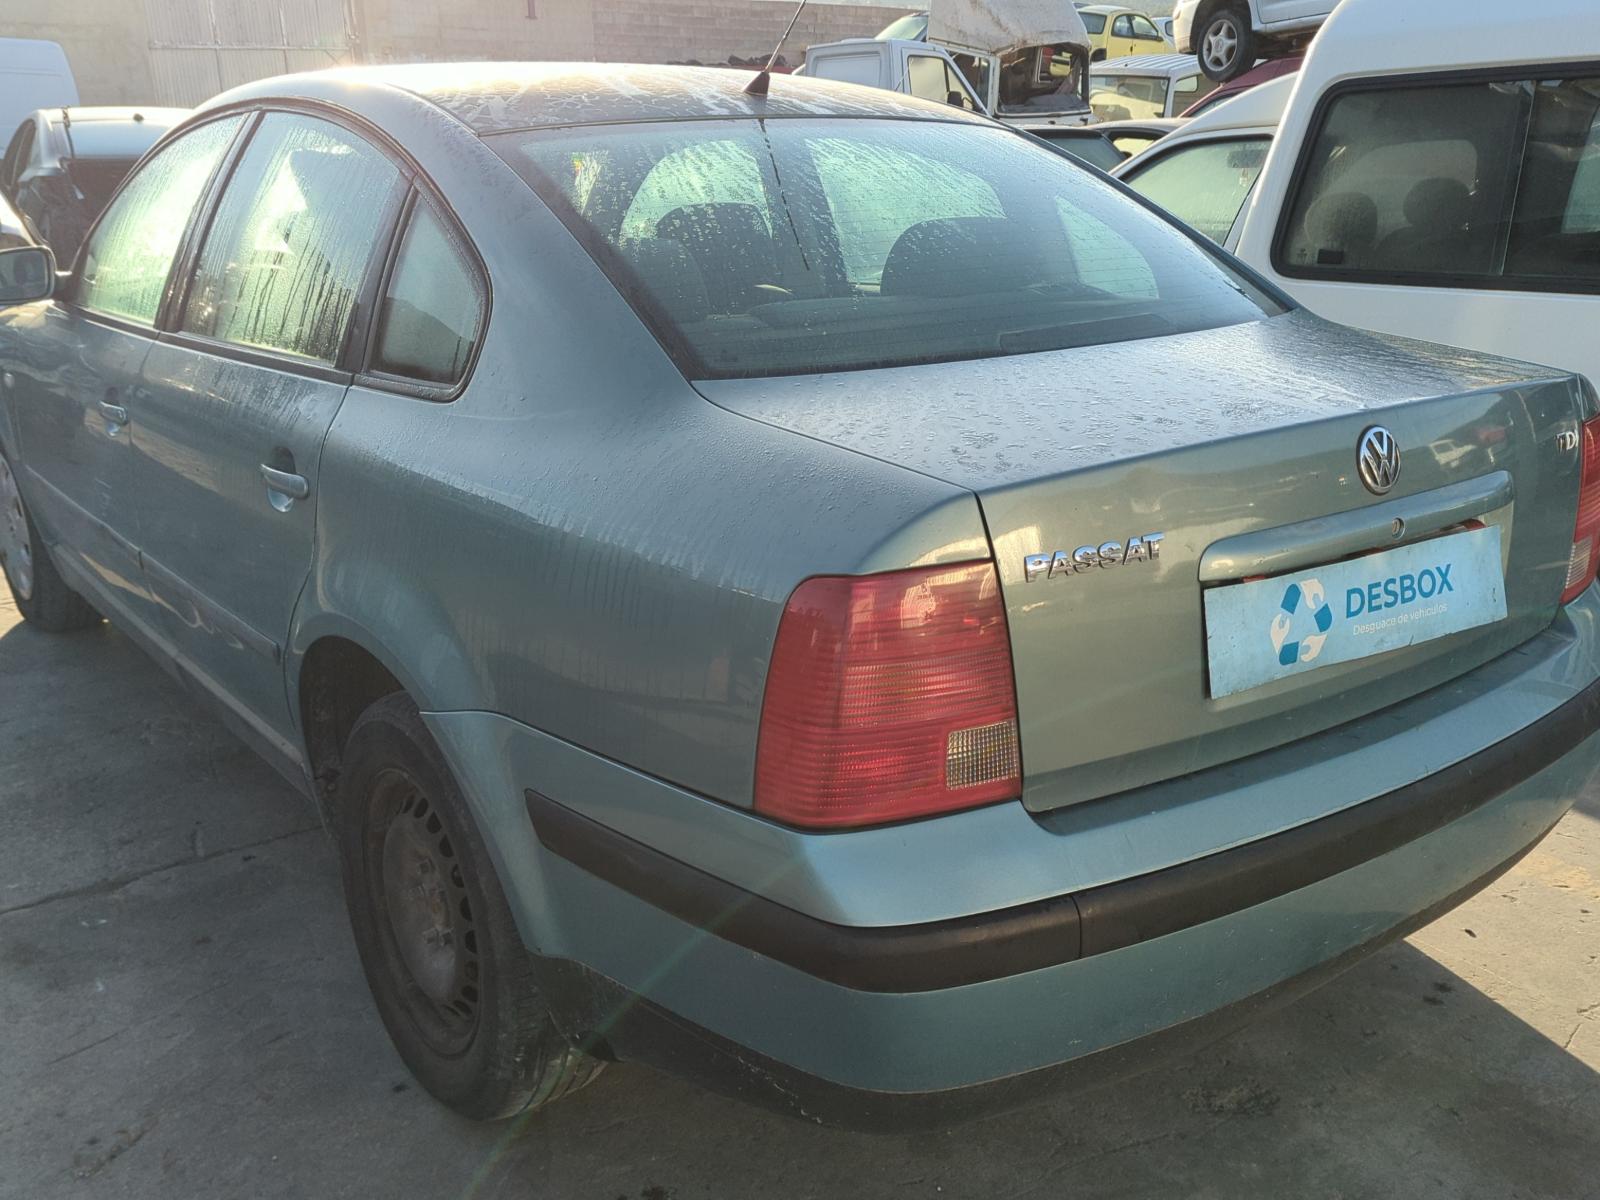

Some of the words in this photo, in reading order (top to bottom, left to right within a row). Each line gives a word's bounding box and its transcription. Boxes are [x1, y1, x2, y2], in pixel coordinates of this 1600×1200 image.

[1024, 532, 1165, 583] PASSAT
[1346, 564, 1454, 619] DESBOX
[1353, 617, 1396, 635] Desguace
[1397, 612, 1409, 625] de
